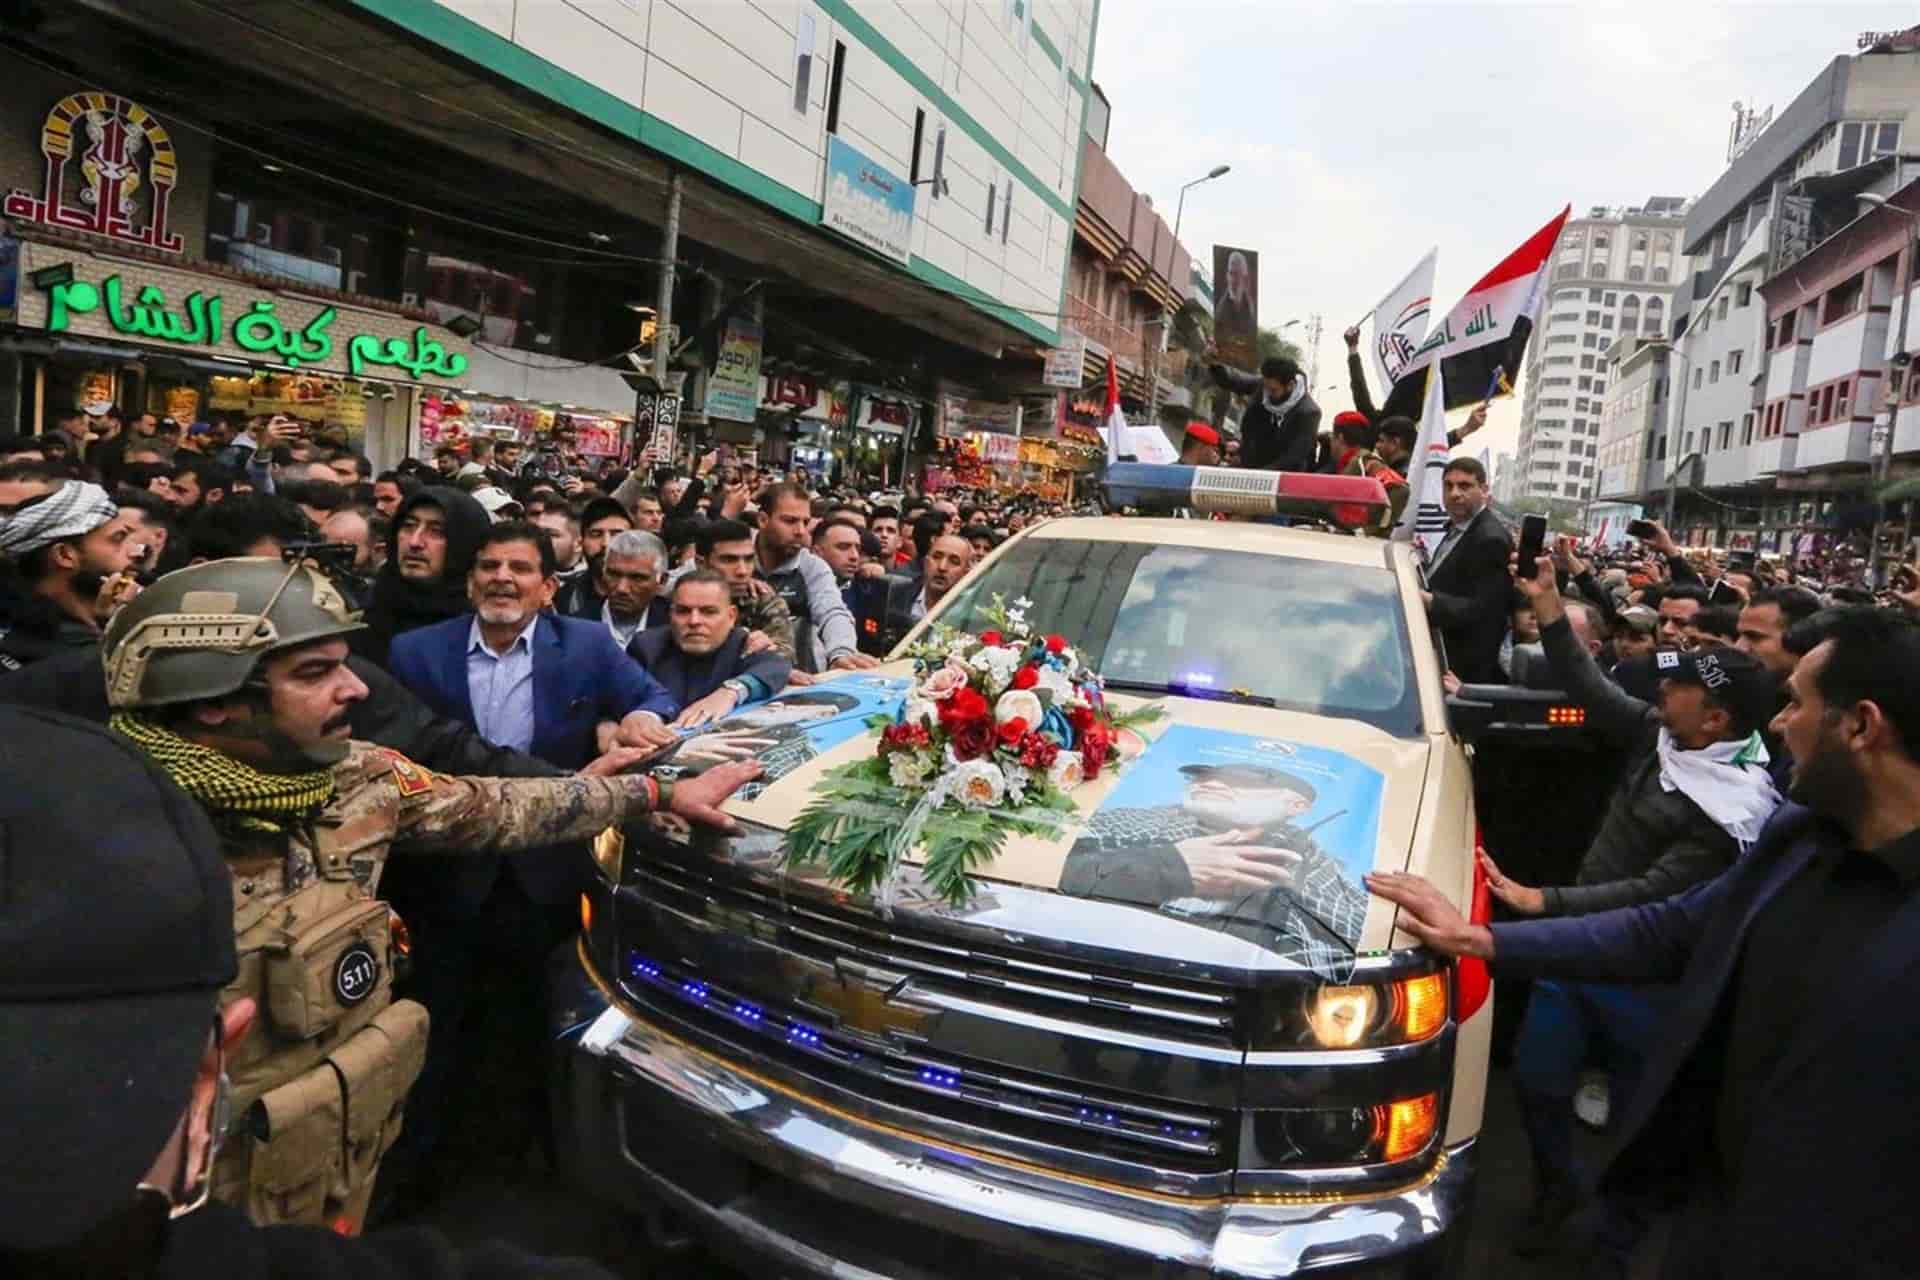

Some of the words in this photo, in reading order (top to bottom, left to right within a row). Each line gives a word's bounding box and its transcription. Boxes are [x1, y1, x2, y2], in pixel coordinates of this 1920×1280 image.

[47, 274, 224, 347] الشام
[233, 301, 337, 367] كبة
[1465, 303, 1498, 337] الله
[349, 327, 470, 377] مطعم
[342, 960, 372, 990] 5.11
